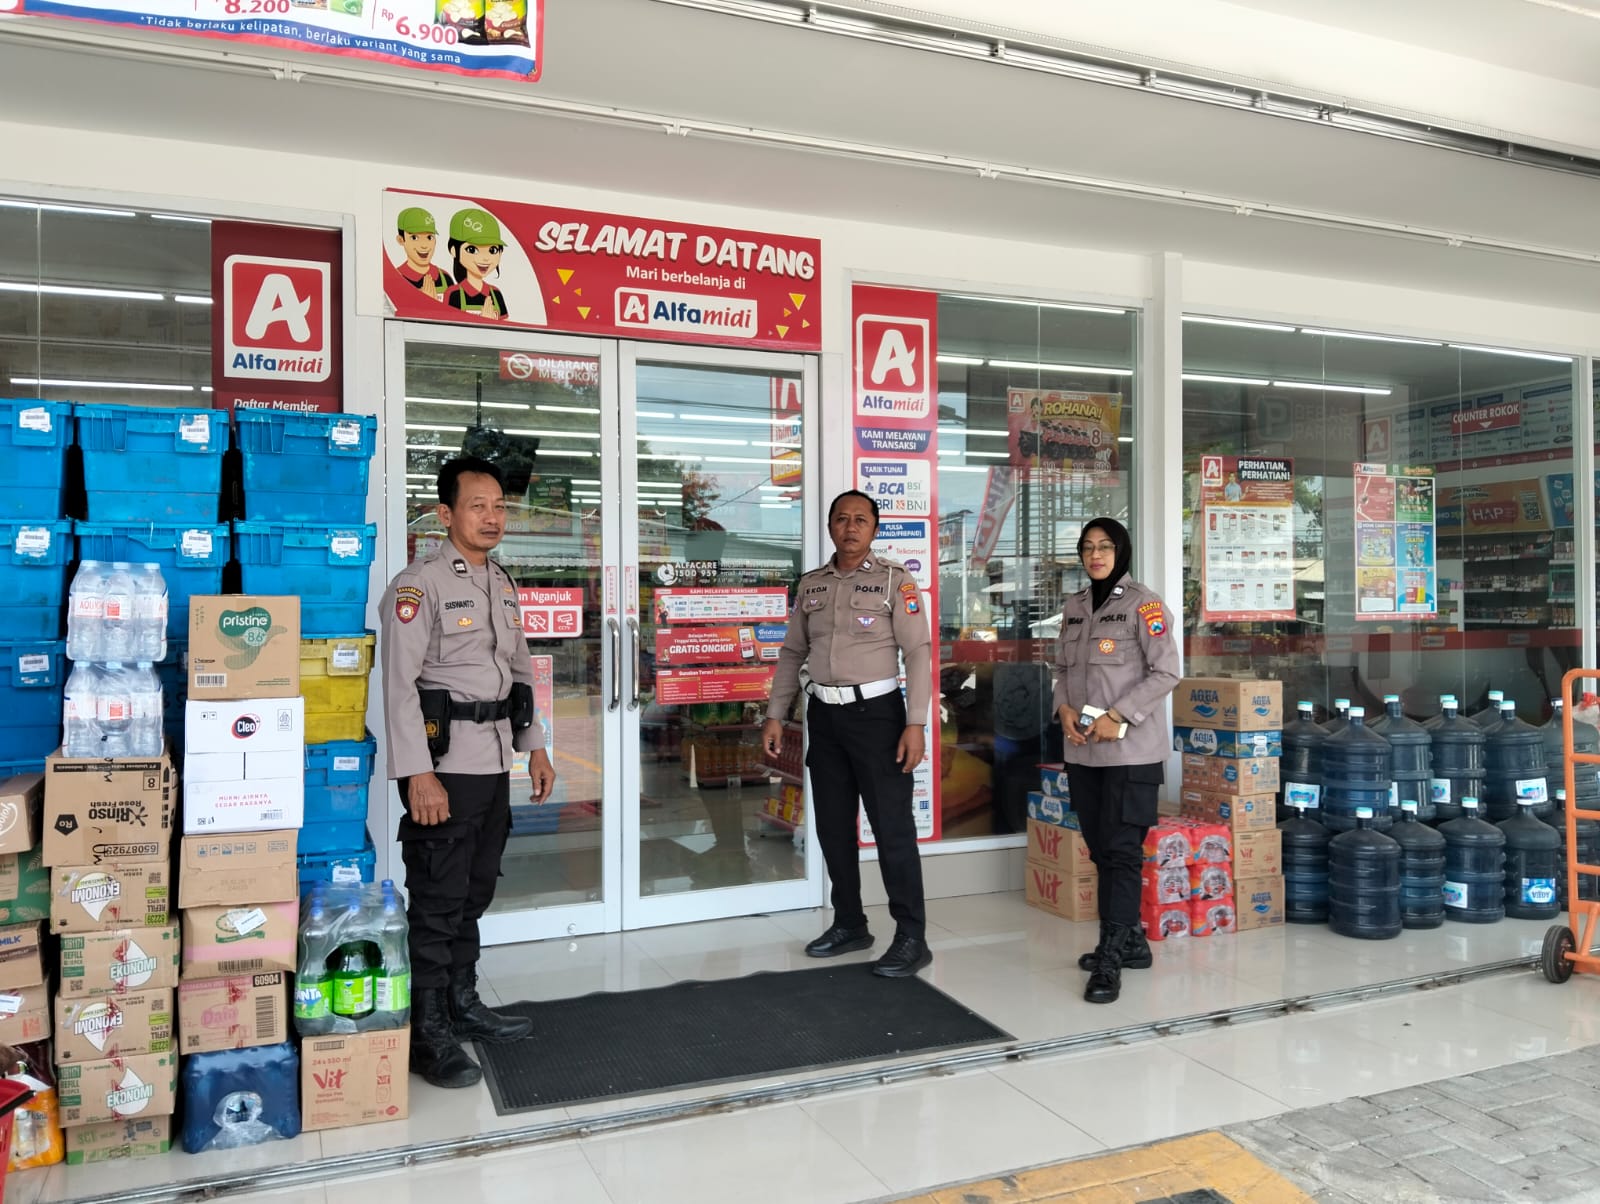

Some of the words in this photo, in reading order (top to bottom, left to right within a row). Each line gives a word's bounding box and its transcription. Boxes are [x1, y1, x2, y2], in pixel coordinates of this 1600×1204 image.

[225, 0, 290, 14] 8.200
[382, 9, 394, 21] Rp
[395, 16, 457, 45] 6.900
[187, 20, 235, 31] berlaku
[240, 20, 302, 38] kelipatan,
[306, 27, 350, 46] berlaku
[354, 38, 398, 53] variant
[400, 45, 427, 62] yang
[431, 53, 461, 64] sama
[535, 220, 688, 263] SELAMAT
[695, 235, 815, 281] DATANG
[626, 265, 658, 281] Mari
[661, 267, 730, 289] berbelanja
[733, 274, 746, 290] di
[653, 300, 752, 329] Alfamidi
[231, 352, 323, 375] Alfamidi
[538, 358, 598, 371] DILARANG
[539, 368, 598, 382] MEROKOK
[233, 398, 270, 411] Daftar
[272, 400, 320, 412] Member
[862, 394, 924, 412] Alfamidi
[1452, 408, 1488, 424] COUNTER
[1489, 403, 1520, 417] ROKOK
[861, 430, 884, 439] KAMI
[885, 431, 926, 441] MELAYANI
[1090, 428, 1102, 446] 8
[872, 440, 917, 450] TRANSAKSI
[1241, 470, 1290, 480] PERHATIAN!
[878, 482, 905, 495] BCA
[907, 481, 921, 490] BSI
[876, 499, 893, 510] BRI
[907, 500, 927, 511] BNI
[675, 569, 697, 577] 1500
[701, 569, 717, 577] 959
[855, 585, 884, 593] POLRI
[444, 600, 475, 610] SISWANTO
[531, 591, 572, 606] Nganjuk
[223, 615, 268, 628] pristine
[1099, 613, 1127, 623] POLRI
[669, 644, 700, 654] GRATIS
[1190, 689, 1220, 704] AQUA
[1251, 695, 1271, 706] AQUA
[237, 720, 256, 733] Cleo
[1193, 732, 1214, 744] AQUA
[147, 778, 156, 788] 8
[119, 800, 142, 808] Rose
[1044, 799, 1060, 813] AQUA
[88, 807, 130, 823] Rinso
[59, 819, 73, 829] Ro
[1035, 825, 1063, 860] Vit
[1240, 848, 1254, 858] Vit
[1033, 868, 1063, 905] Vit
[72, 883, 121, 904] EKONOMI
[1079, 890, 1094, 902] Vit
[1251, 892, 1272, 904] AQUA
[147, 904, 166, 912] REFILL
[64, 951, 83, 959] REFILL
[110, 957, 157, 980] EKONOMI
[254, 974, 279, 986] 60904
[295, 987, 322, 1001] ANTA
[74, 1011, 124, 1035] EKONOMI
[151, 1031, 169, 1039] REFILL
[61, 1080, 79, 1088] REFILL
[312, 1068, 348, 1089] Vit
[107, 1084, 153, 1108] EKONOMI
